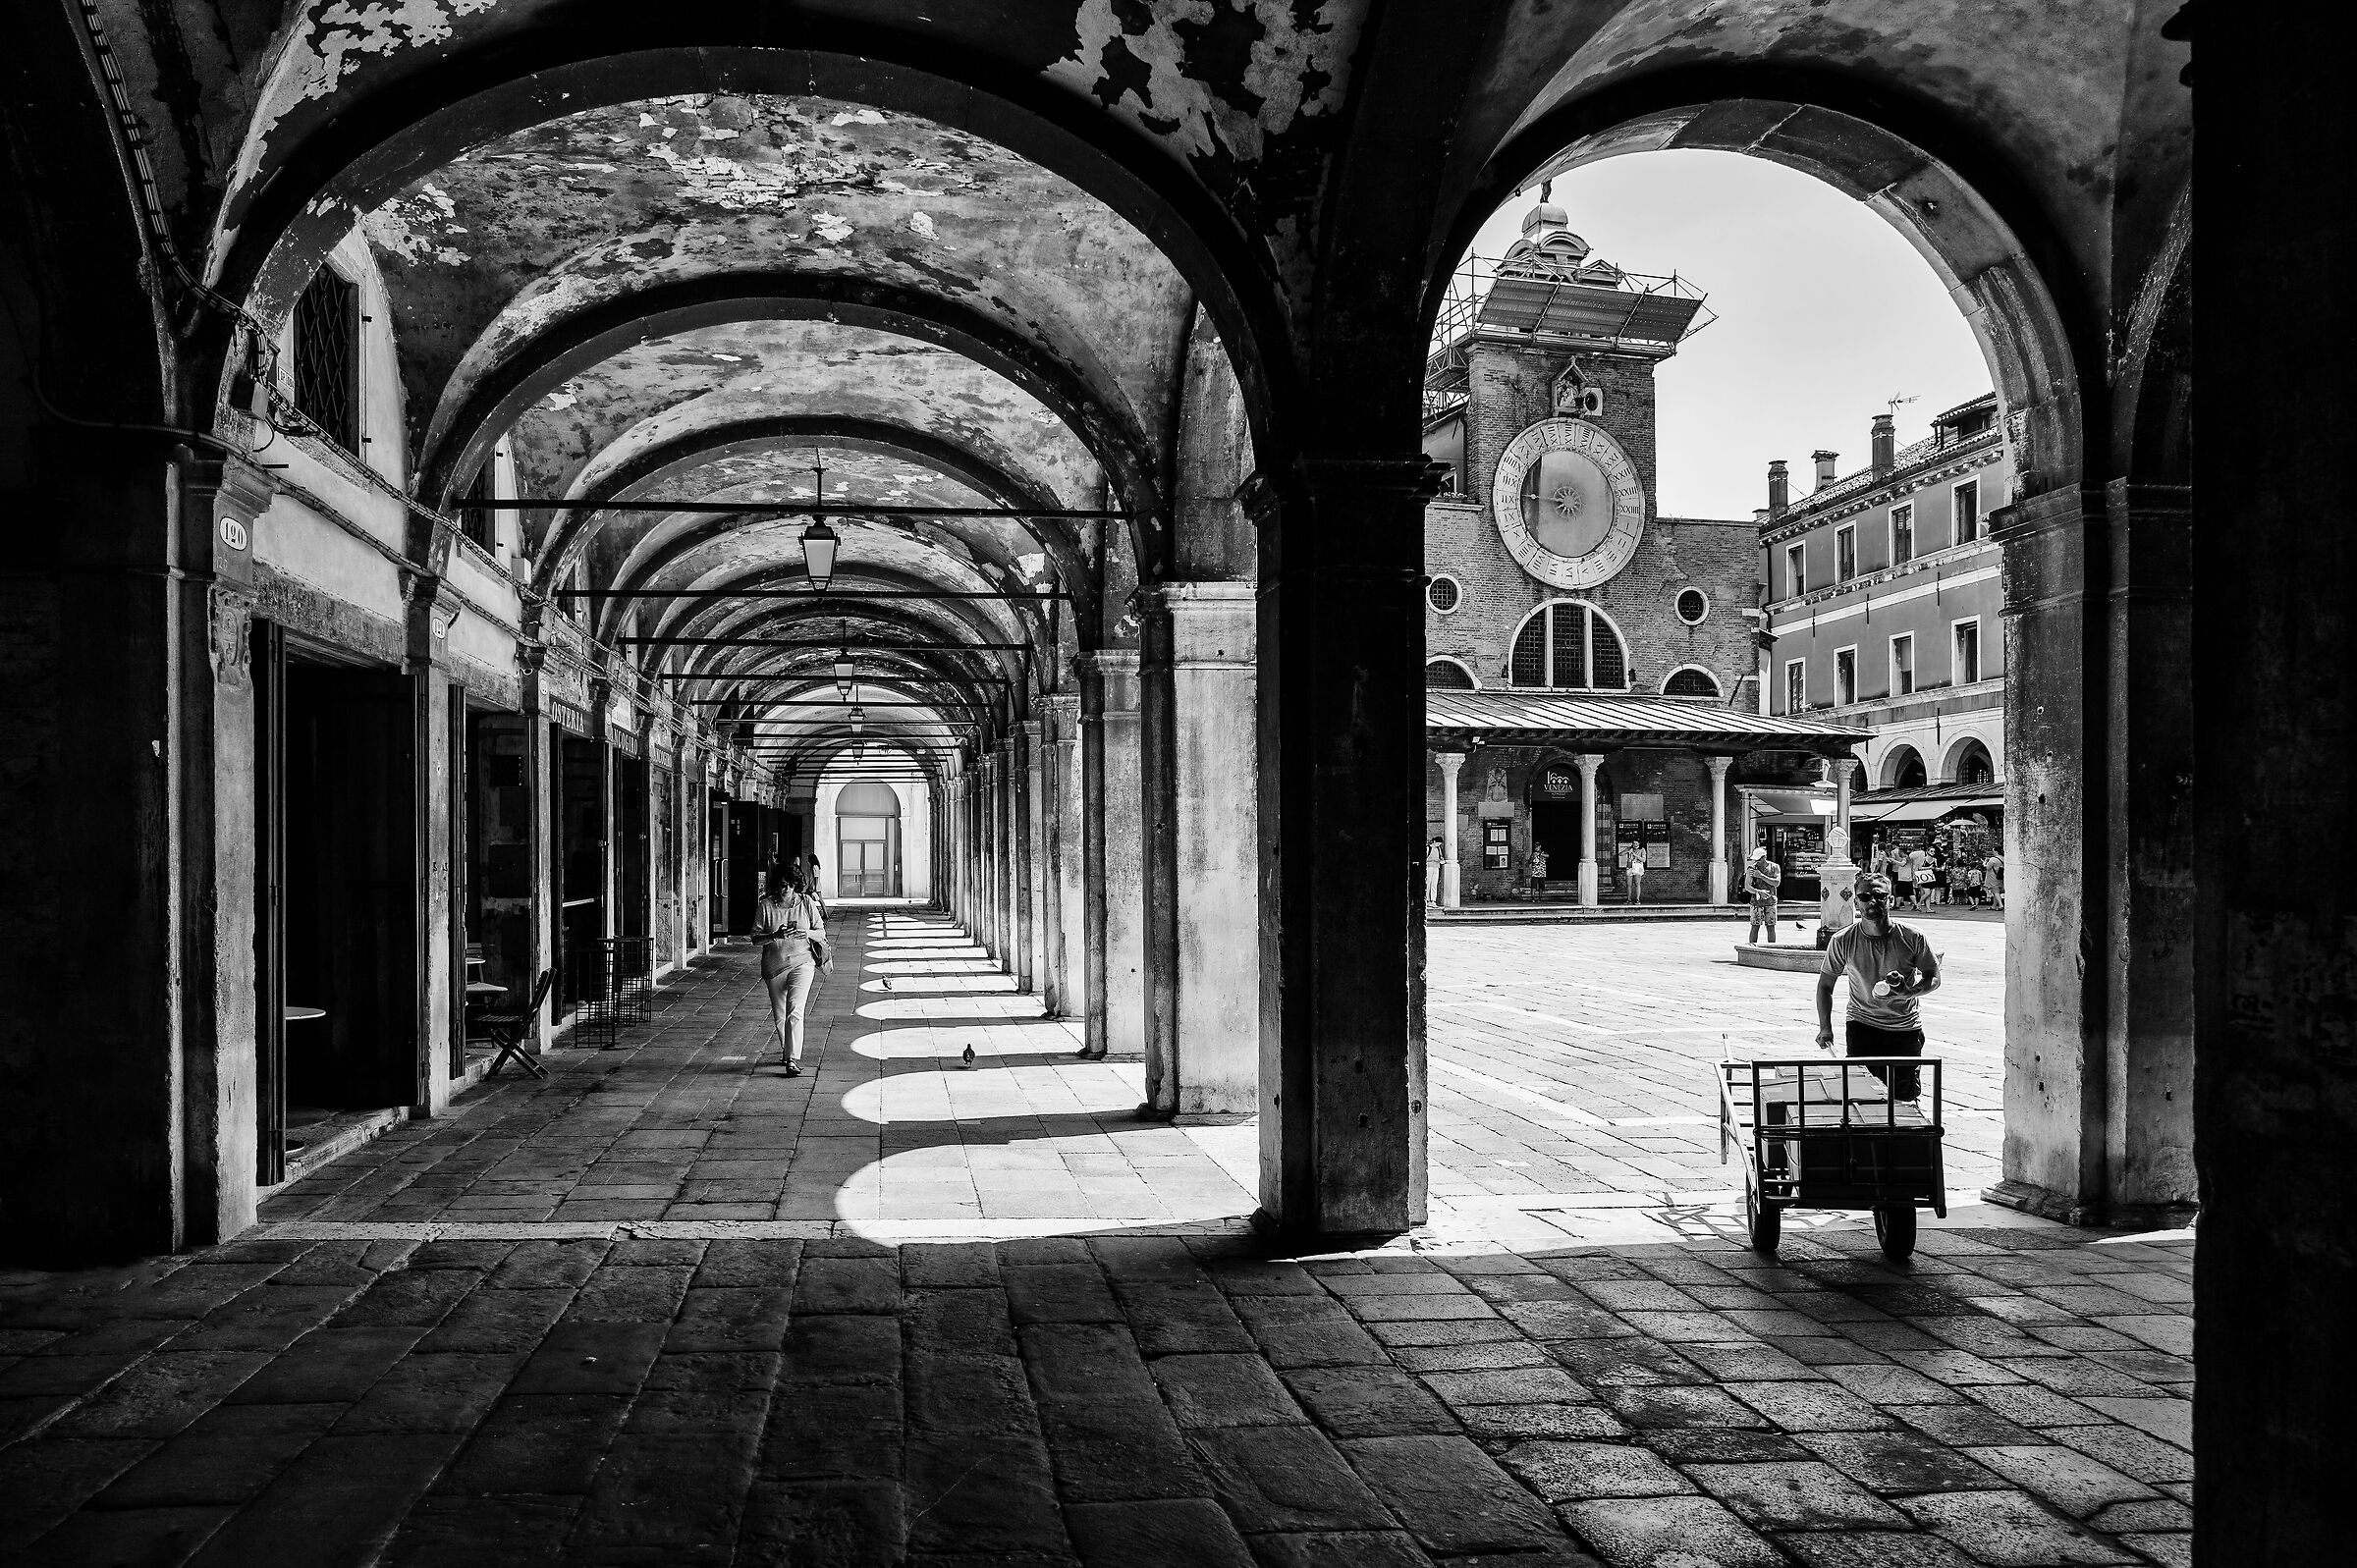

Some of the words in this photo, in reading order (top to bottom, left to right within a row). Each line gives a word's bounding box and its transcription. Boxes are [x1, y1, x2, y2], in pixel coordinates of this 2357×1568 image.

[225, 522, 244, 545] 120
[552, 701, 584, 733] OSTERIA
[613, 728, 638, 755] NCOGIRO
